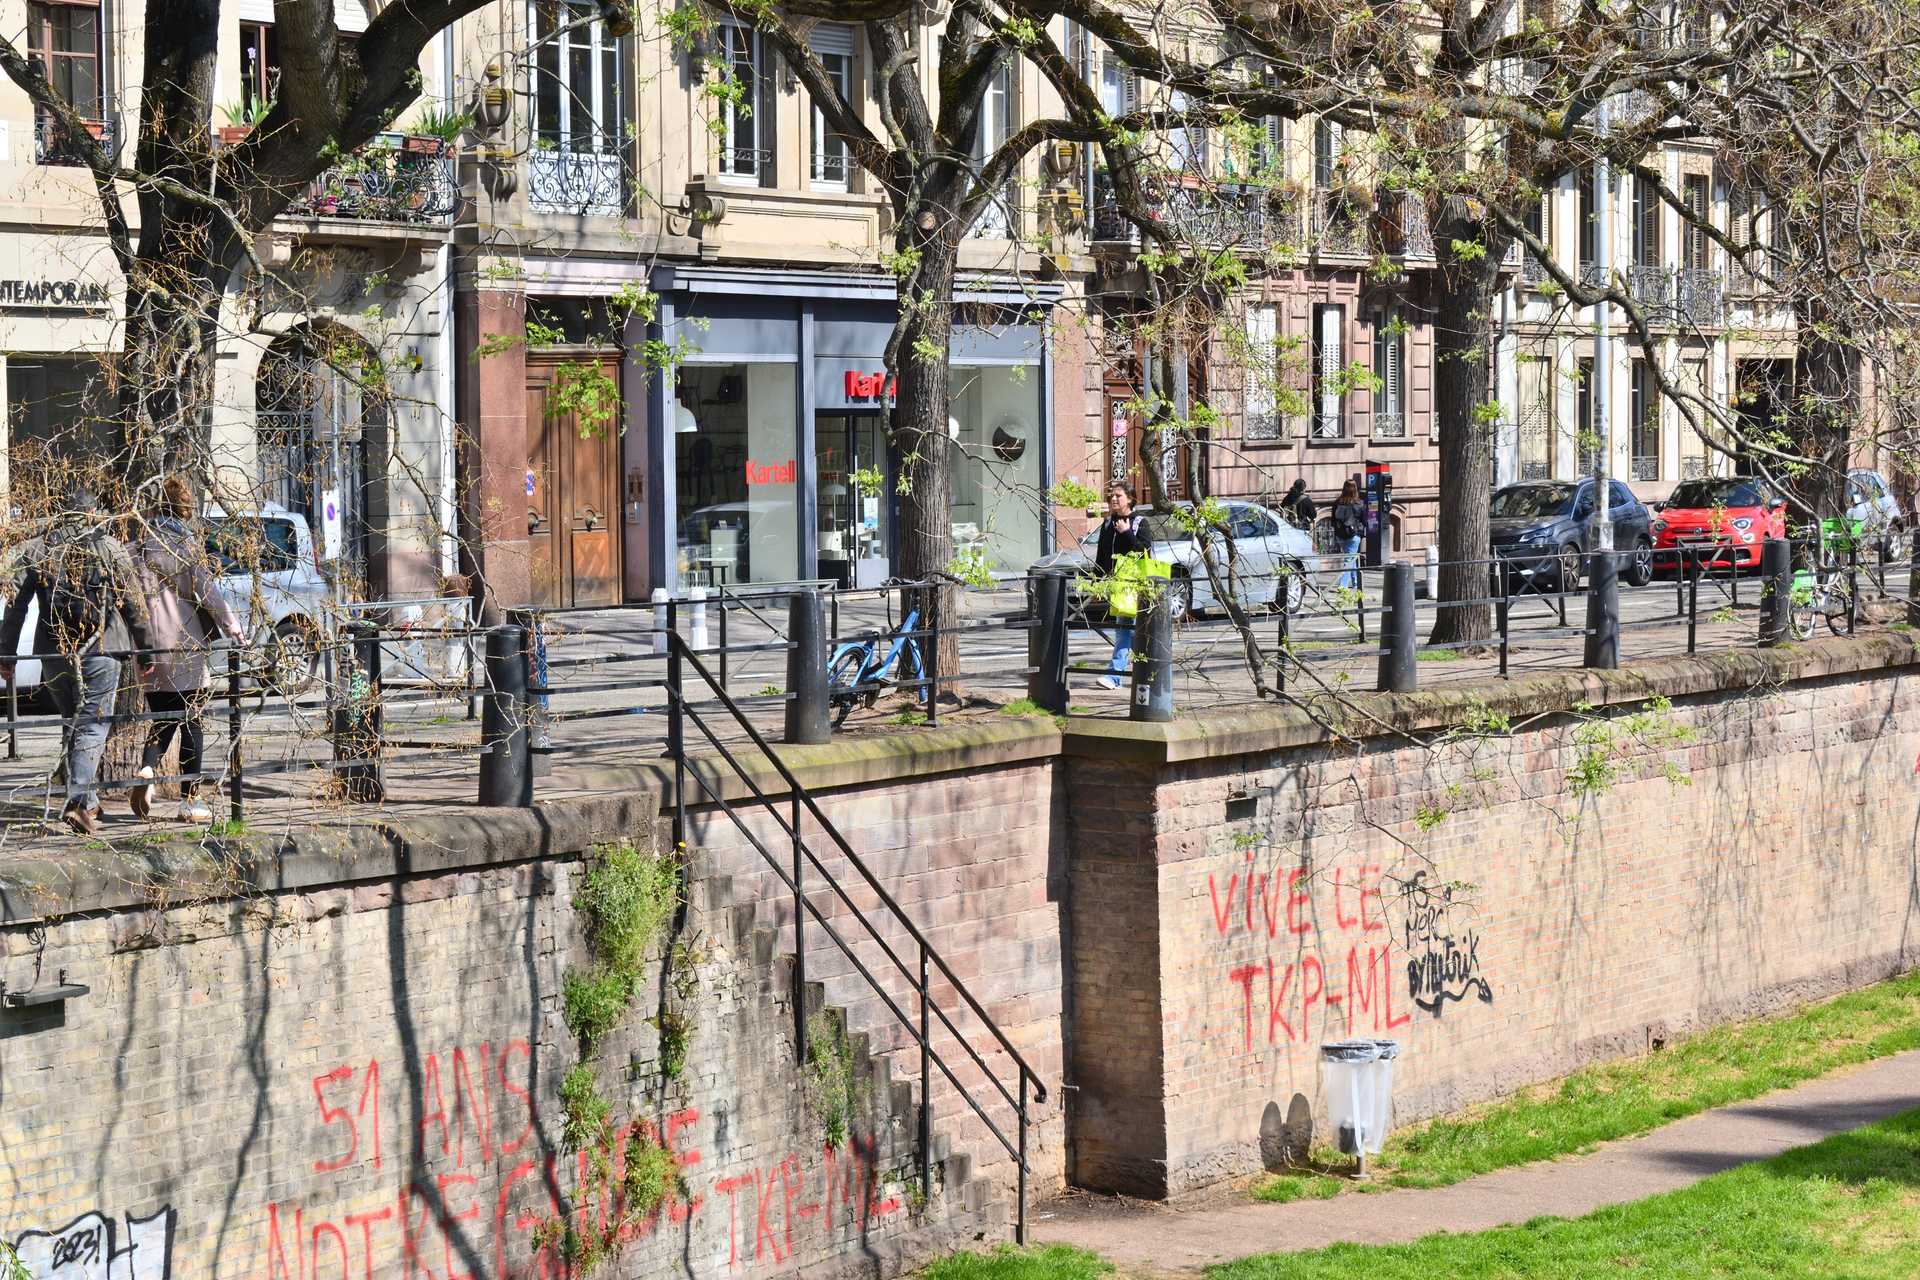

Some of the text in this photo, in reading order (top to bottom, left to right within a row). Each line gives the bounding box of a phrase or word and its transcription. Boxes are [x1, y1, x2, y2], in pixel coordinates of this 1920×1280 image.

[745, 460, 796, 486] Kartell
[1334, 865, 1384, 932] LE
[1229, 944, 1411, 1052] TKP-ML
[313, 1038, 534, 1172] 51 ANS
